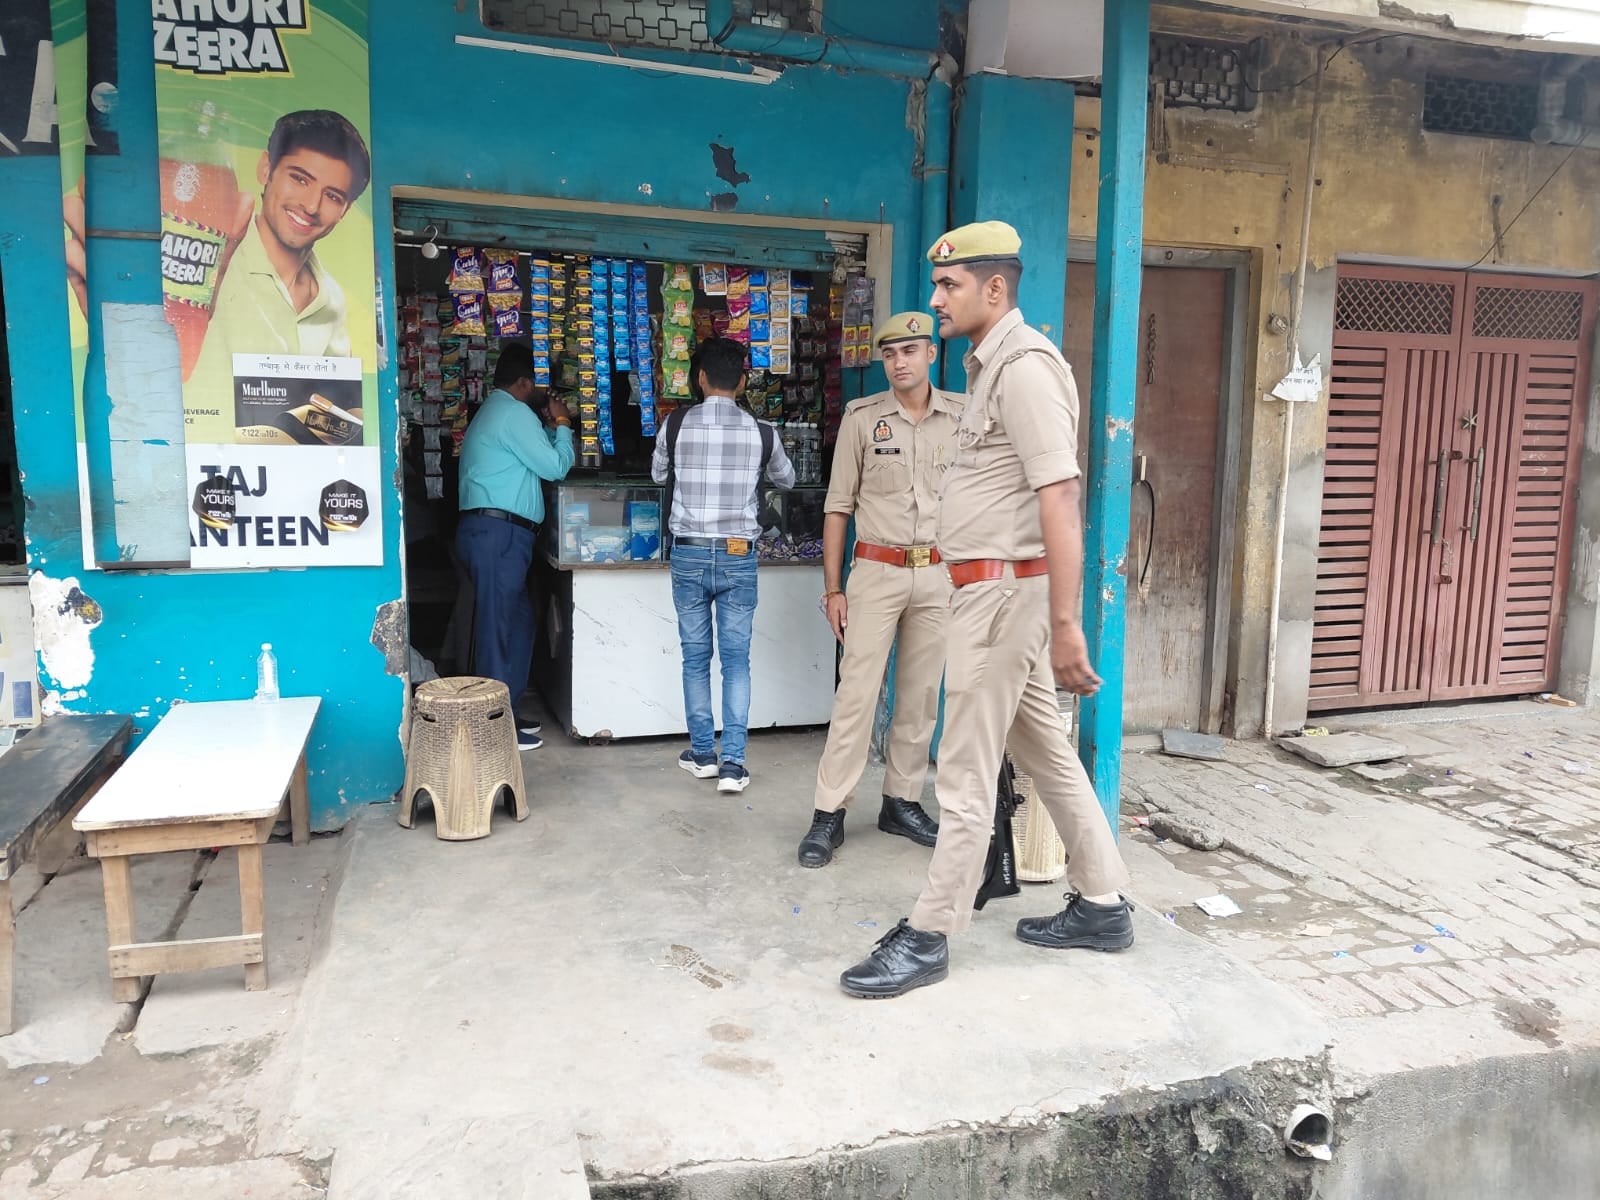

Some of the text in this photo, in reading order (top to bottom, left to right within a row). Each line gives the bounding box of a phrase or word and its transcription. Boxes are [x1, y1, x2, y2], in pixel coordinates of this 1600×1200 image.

[152, 20, 284, 71] ZEERA
[161, 234, 218, 265] AHORI
[161, 256, 205, 283] ZEERA
[242, 380, 287, 397] Marlboro
[200, 465, 267, 497] TAJ
[200, 493, 235, 506] YOURS
[323, 498, 363, 509] YOURS
